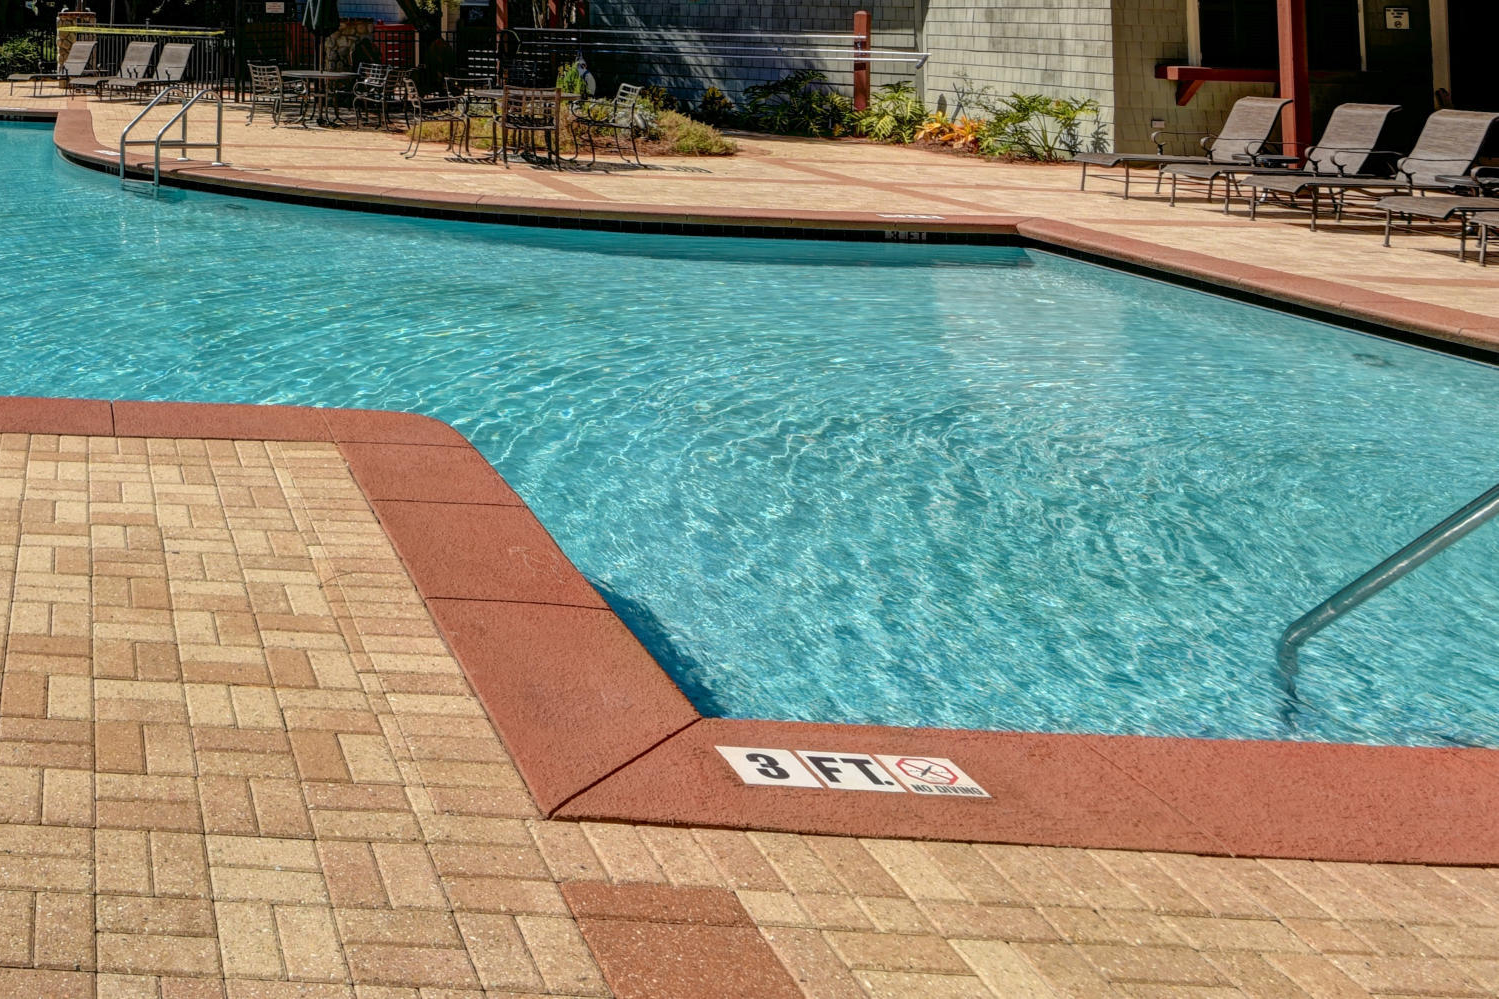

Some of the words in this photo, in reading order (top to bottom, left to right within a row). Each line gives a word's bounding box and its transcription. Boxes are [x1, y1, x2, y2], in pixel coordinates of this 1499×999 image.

[746, 753, 790, 780] 3
[806, 756, 895, 786] FT.
[911, 784, 934, 793] NO
[934, 785, 985, 796] DIVING
